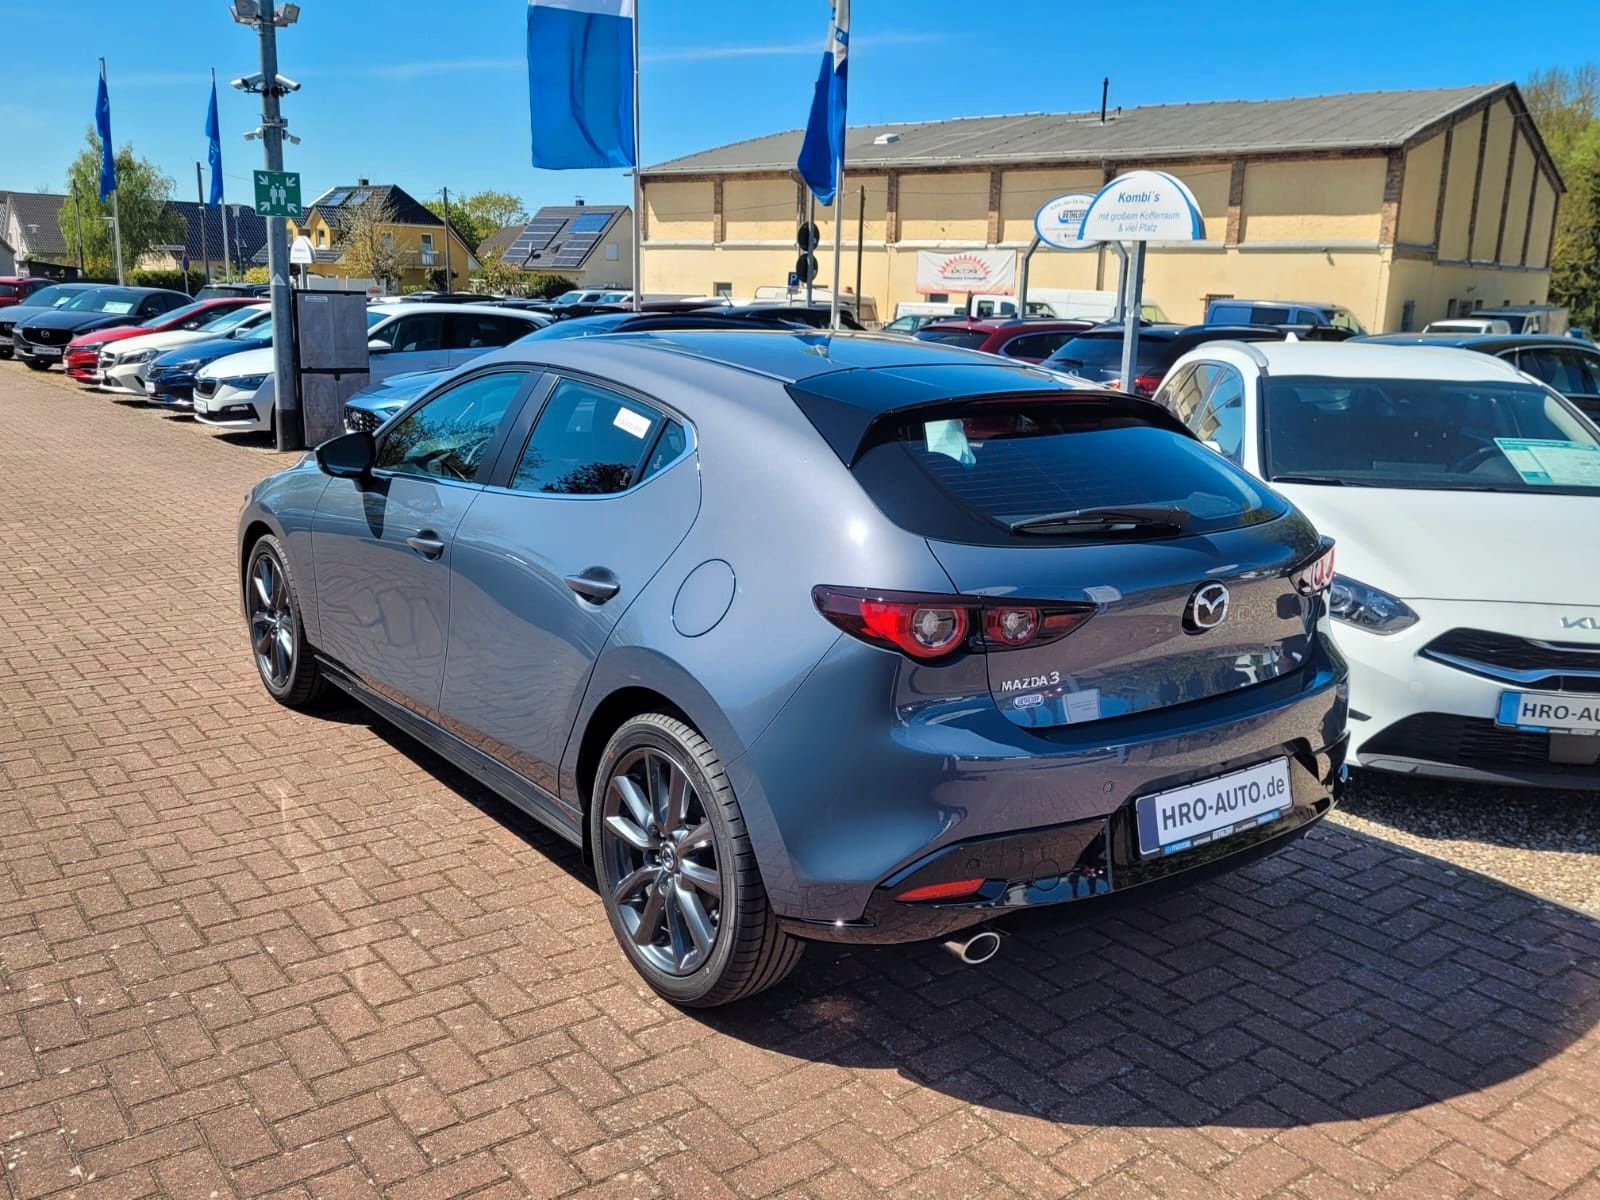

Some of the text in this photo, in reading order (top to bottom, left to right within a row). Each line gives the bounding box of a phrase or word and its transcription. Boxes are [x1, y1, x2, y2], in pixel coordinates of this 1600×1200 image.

[1099, 212, 1109, 220] mit
[1111, 212, 1138, 222] großem
[1140, 210, 1181, 220] Kofferraum
[1125, 223, 1137, 232] viel
[1139, 223, 1158, 233] Platz
[790, 273, 798, 285] P
[1162, 776, 1285, 831] HRO-AUTO.de
